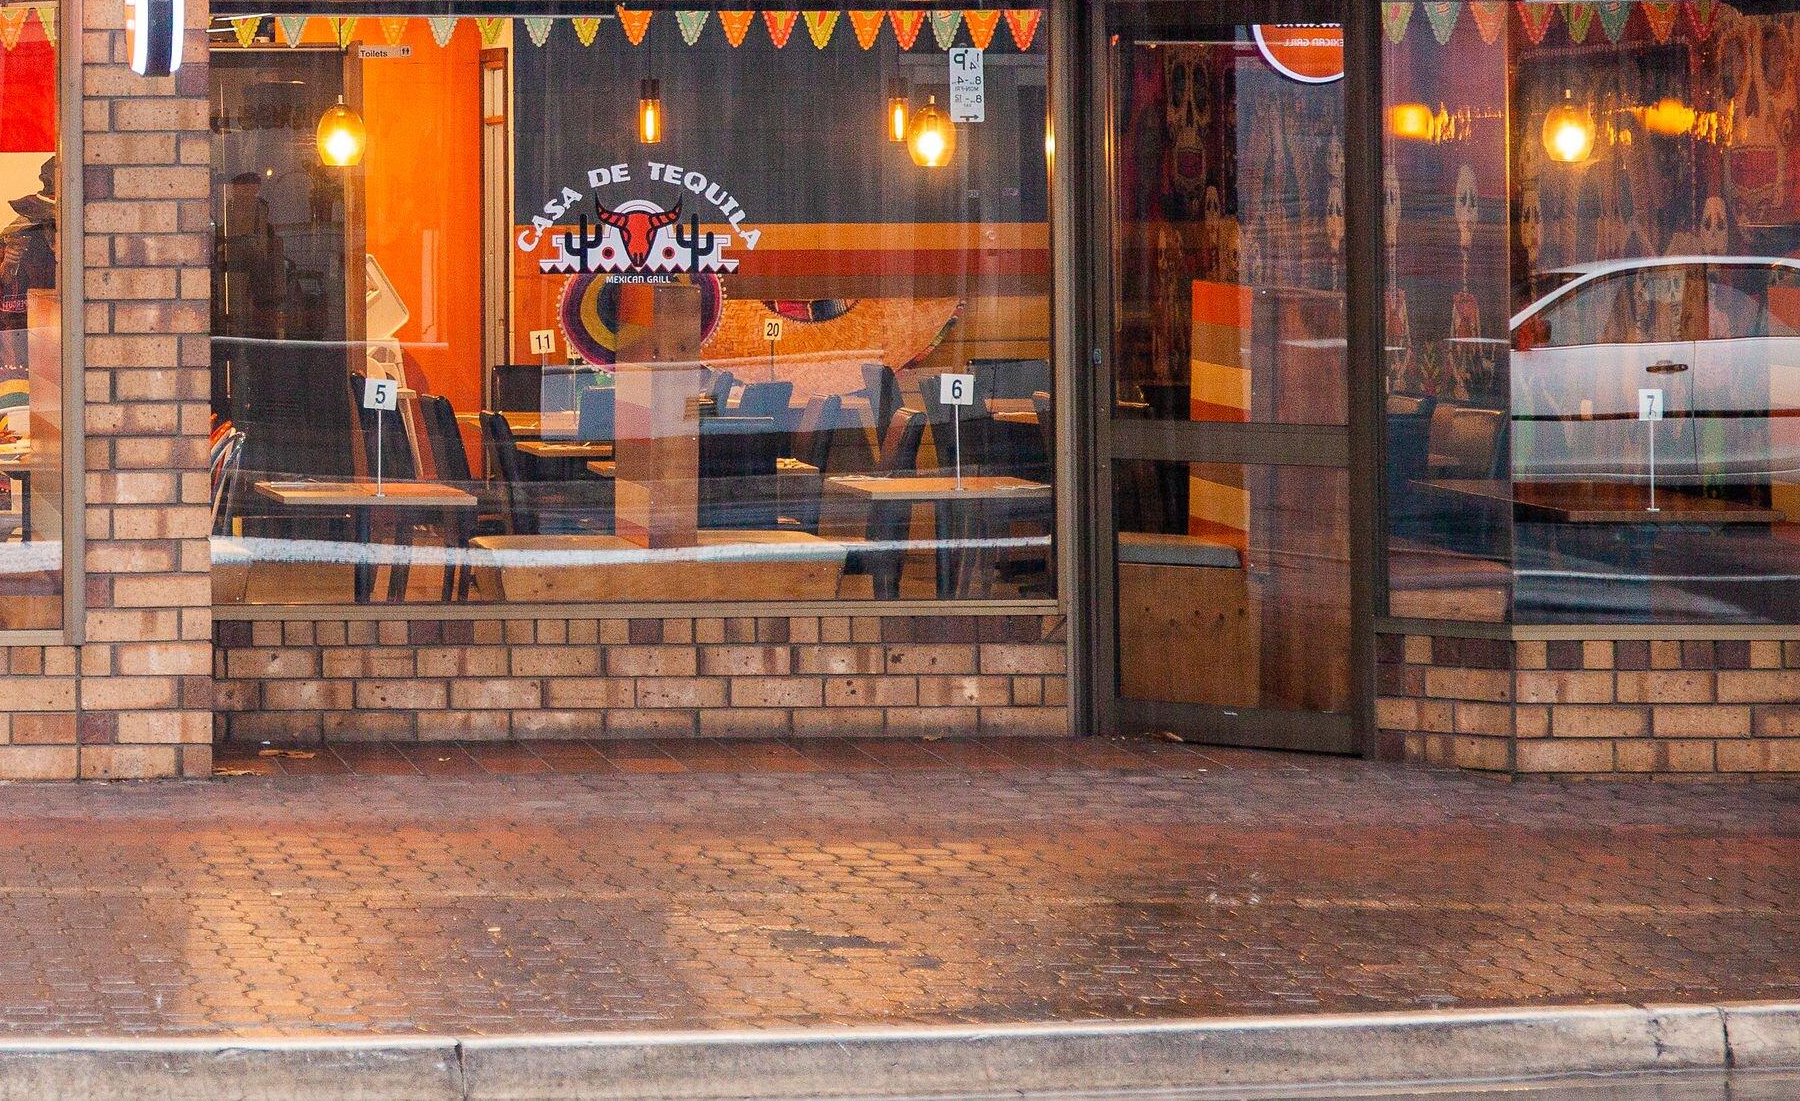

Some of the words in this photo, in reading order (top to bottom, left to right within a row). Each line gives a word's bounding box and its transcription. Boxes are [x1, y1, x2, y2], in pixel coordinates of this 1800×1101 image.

[360, 50, 388, 58] Toilets
[517, 186, 583, 252] CASA
[587, 163, 631, 188] DE
[648, 161, 762, 251] TEQUILA
[606, 275, 645, 284] MEXICAN
[646, 275, 672, 284] GRILL
[766, 322, 780, 337] 20
[535, 334, 550, 350] 11
[375, 384, 387, 404] 5
[951, 379, 963, 399] 6
[1646, 394, 1656, 415] 7
